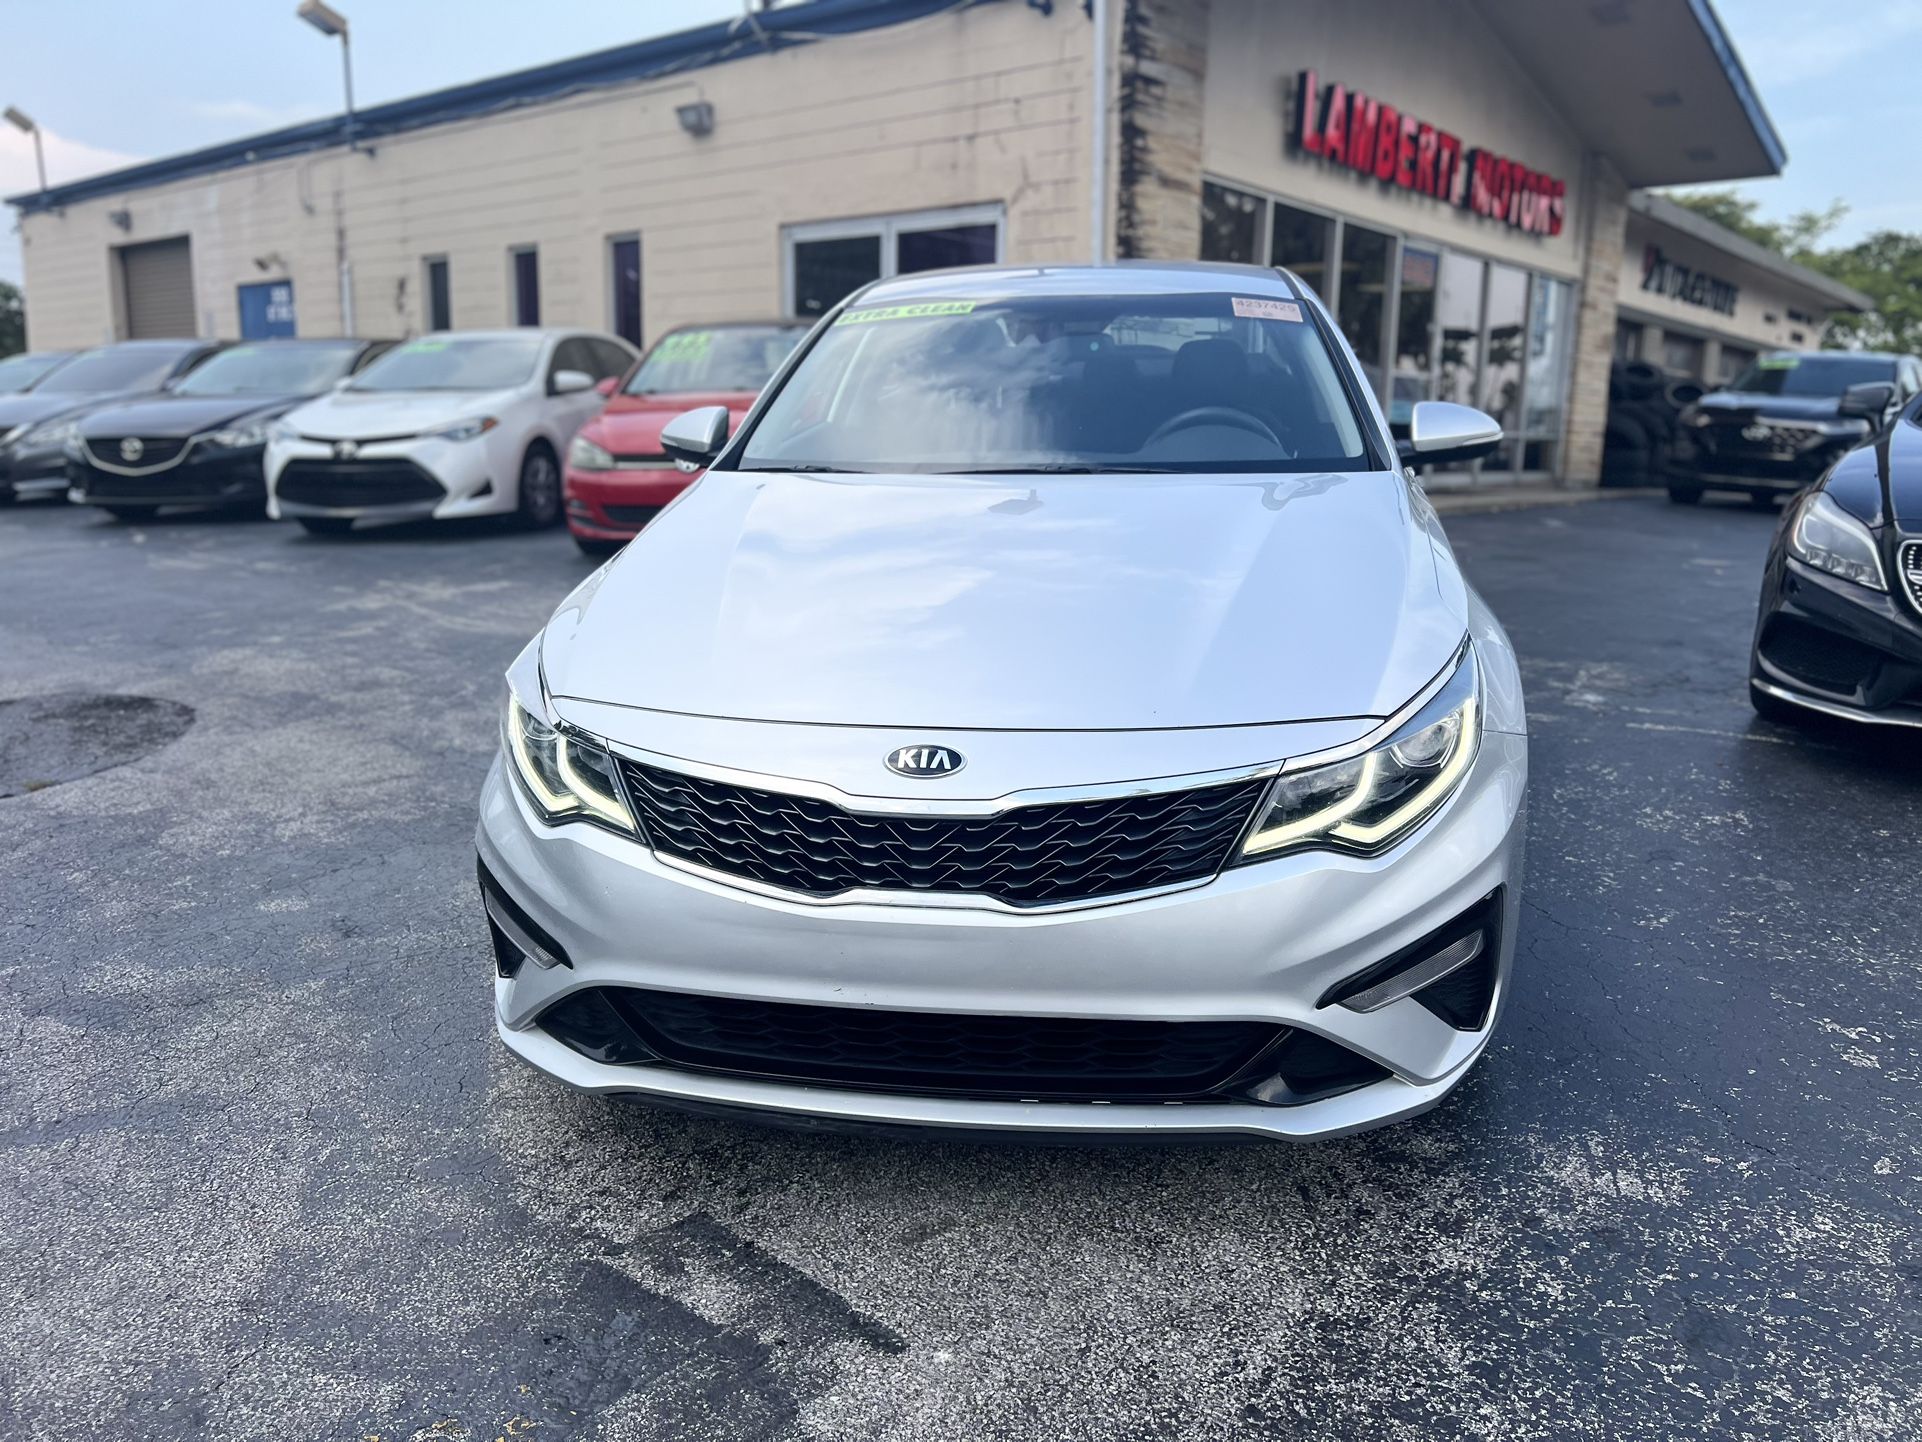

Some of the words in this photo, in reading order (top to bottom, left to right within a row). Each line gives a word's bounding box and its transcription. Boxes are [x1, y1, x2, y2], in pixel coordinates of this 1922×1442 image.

[1471, 148, 1566, 237] MOTORS
[906, 302, 972, 315] CLEAN
[897, 748, 952, 770] KIA
